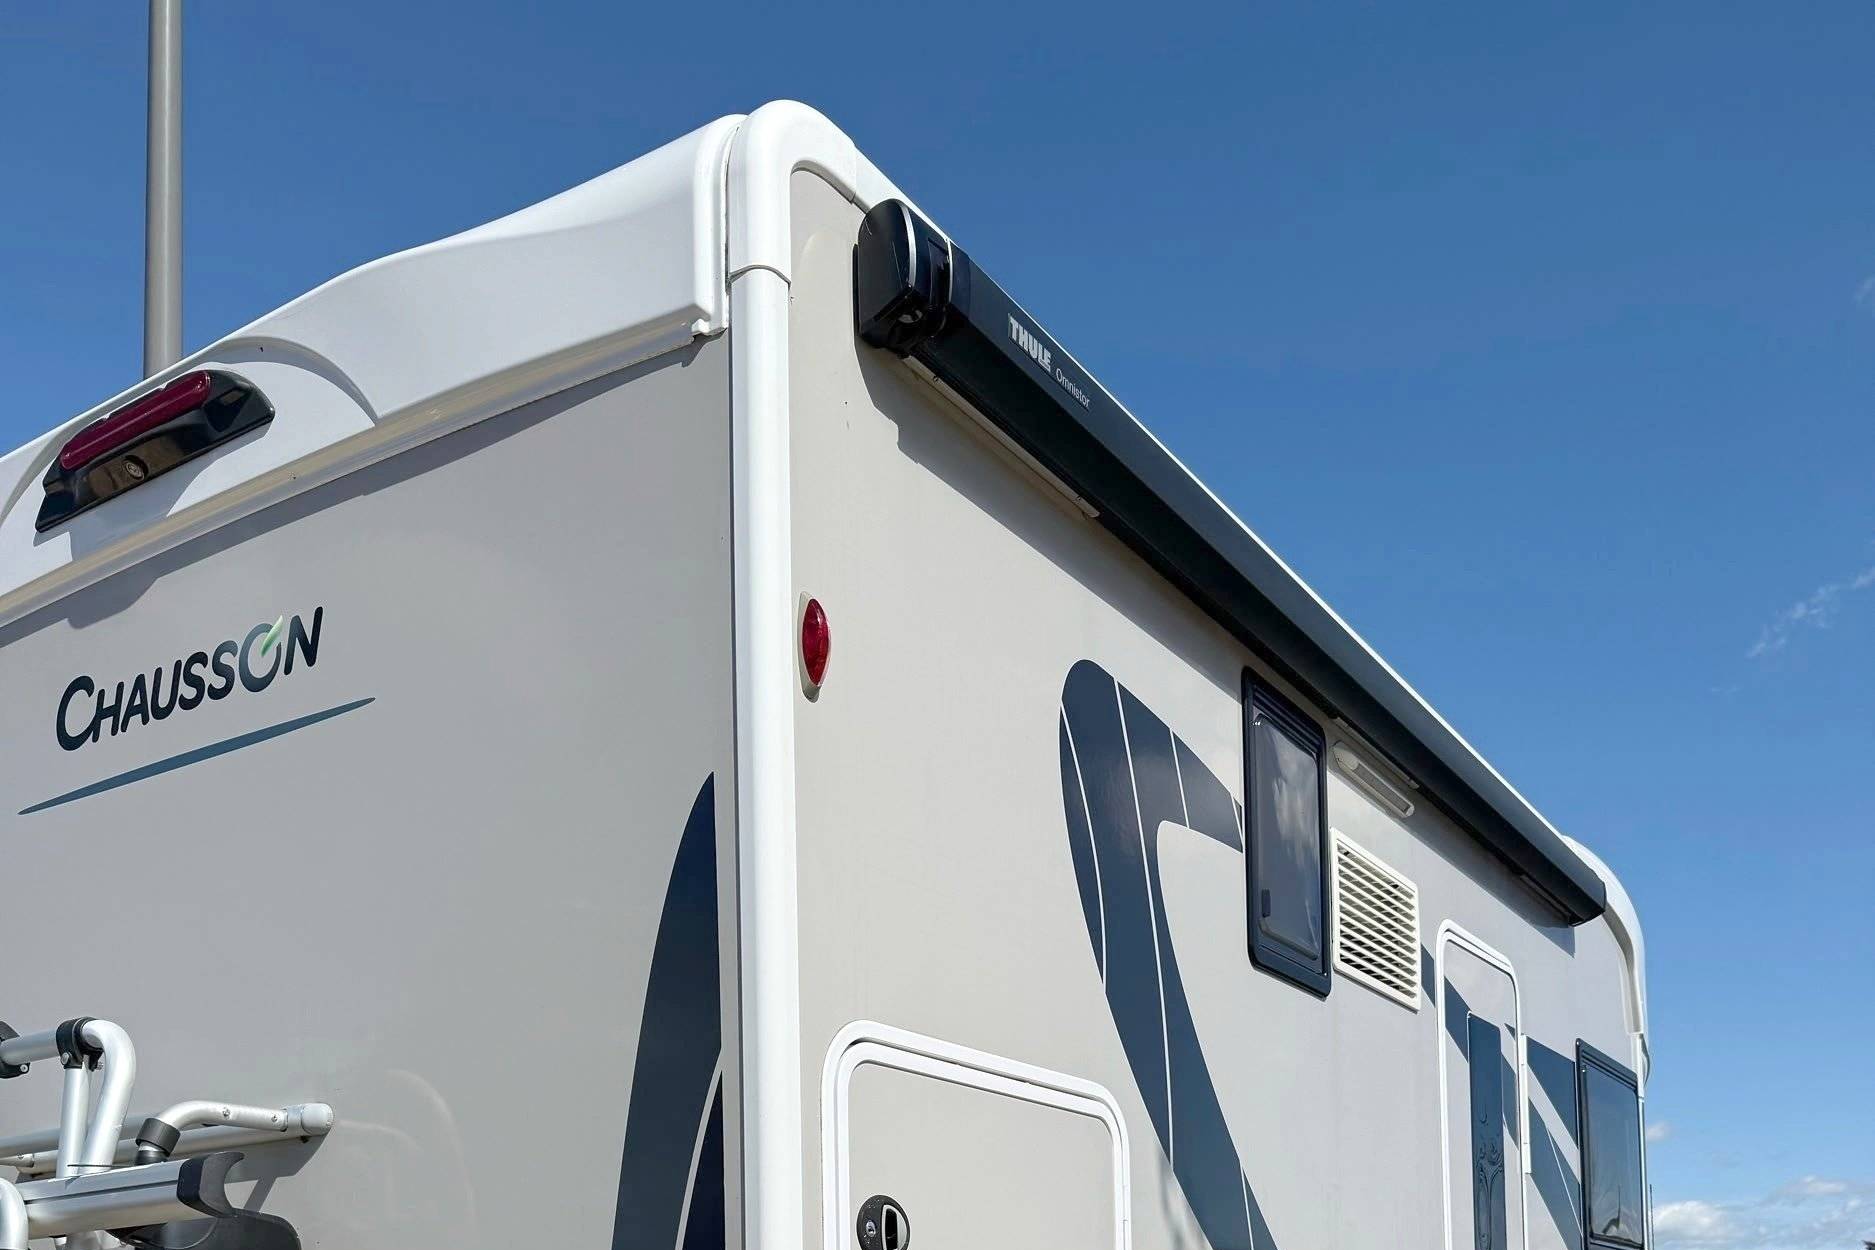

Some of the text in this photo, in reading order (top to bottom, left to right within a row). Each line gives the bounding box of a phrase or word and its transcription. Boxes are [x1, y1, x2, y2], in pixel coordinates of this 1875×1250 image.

[1009, 314, 1090, 408] THULE Omnistor
[56, 606, 324, 751] CHAUSSON
